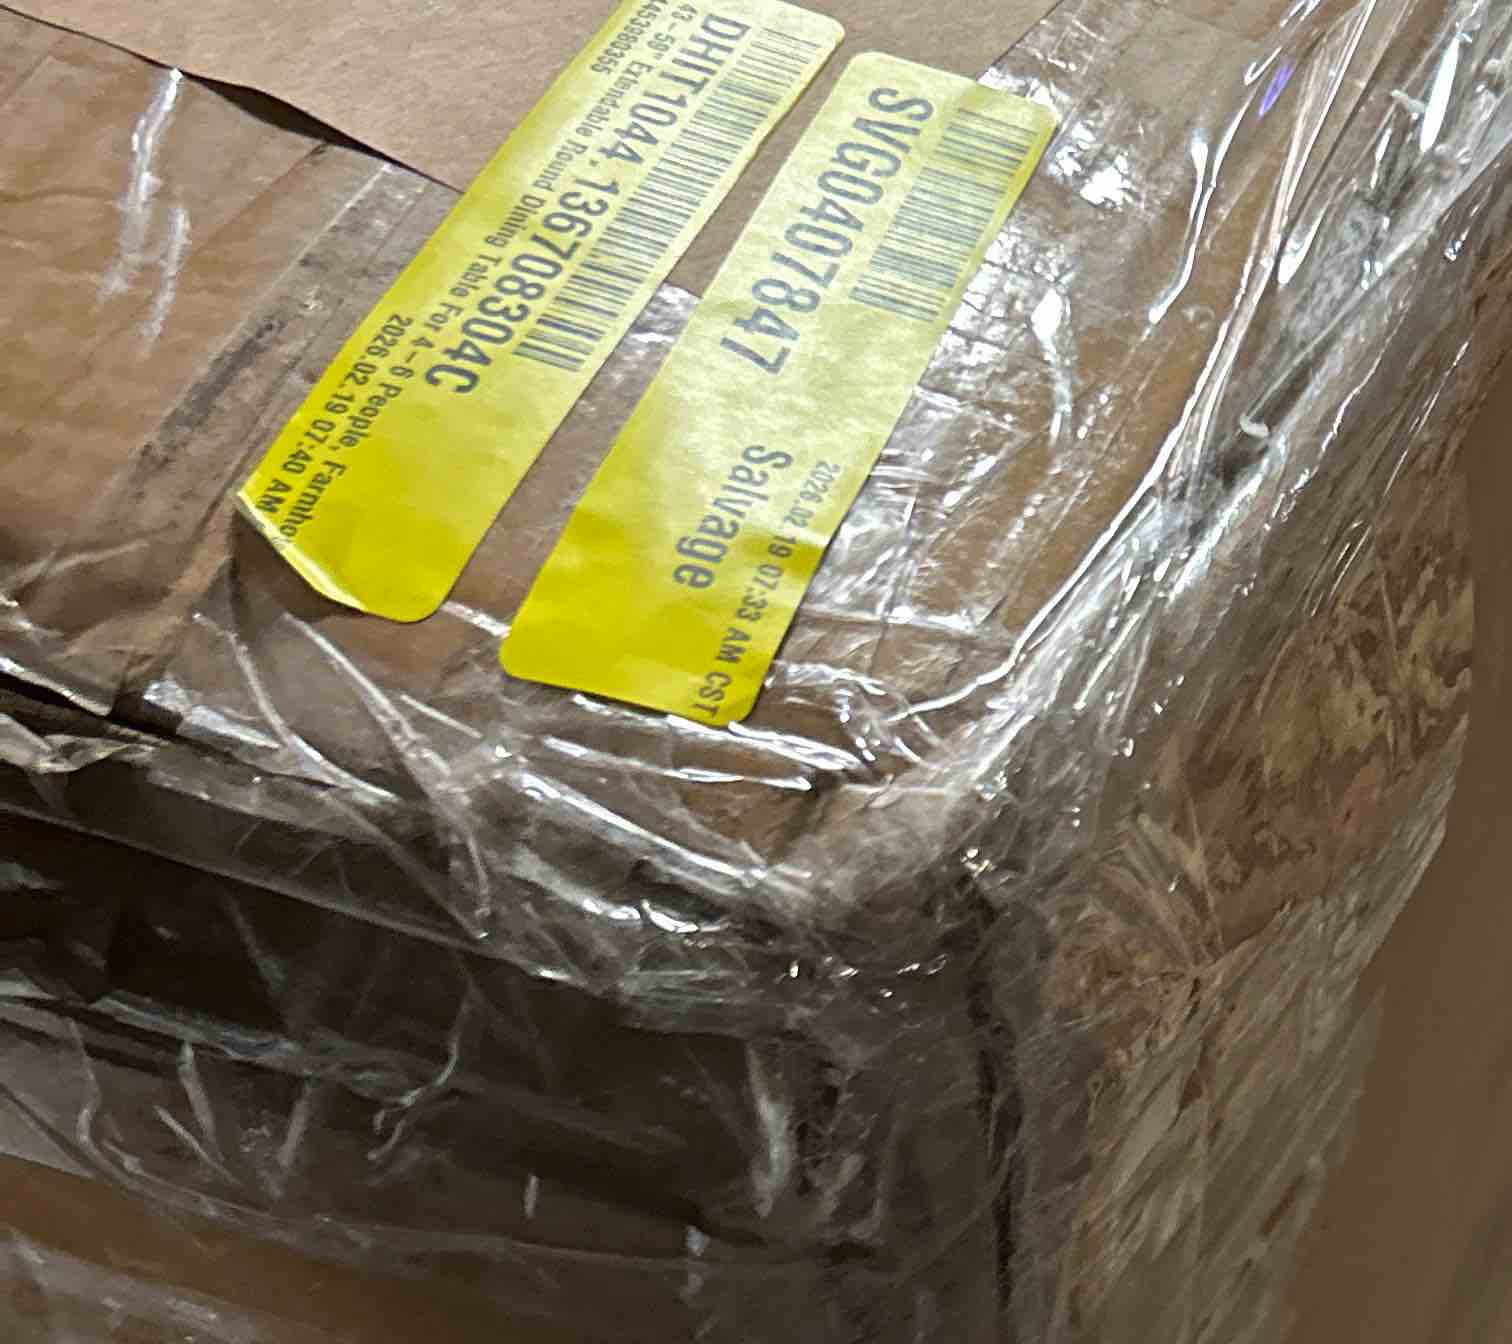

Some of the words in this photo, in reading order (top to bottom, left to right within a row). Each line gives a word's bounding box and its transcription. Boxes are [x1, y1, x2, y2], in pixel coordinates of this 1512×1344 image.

[575, 60, 656, 138] Extendable
[532, 139, 589, 193] Round
[483, 193, 547, 249] Dining
[719, 86, 934, 375] SVG0407847
[450, 253, 504, 298] Table
[423, 302, 465, 332] For
[324, 313, 414, 415] 2026.02.19
[328, 382, 403, 452] People,
[282, 418, 337, 474] 07:40
[255, 478, 293, 514] AM
[672, 444, 793, 589] Salvage
[735, 562, 784, 622] 07:33
[714, 625, 752, 664] AM
[692, 670, 733, 718] CST
